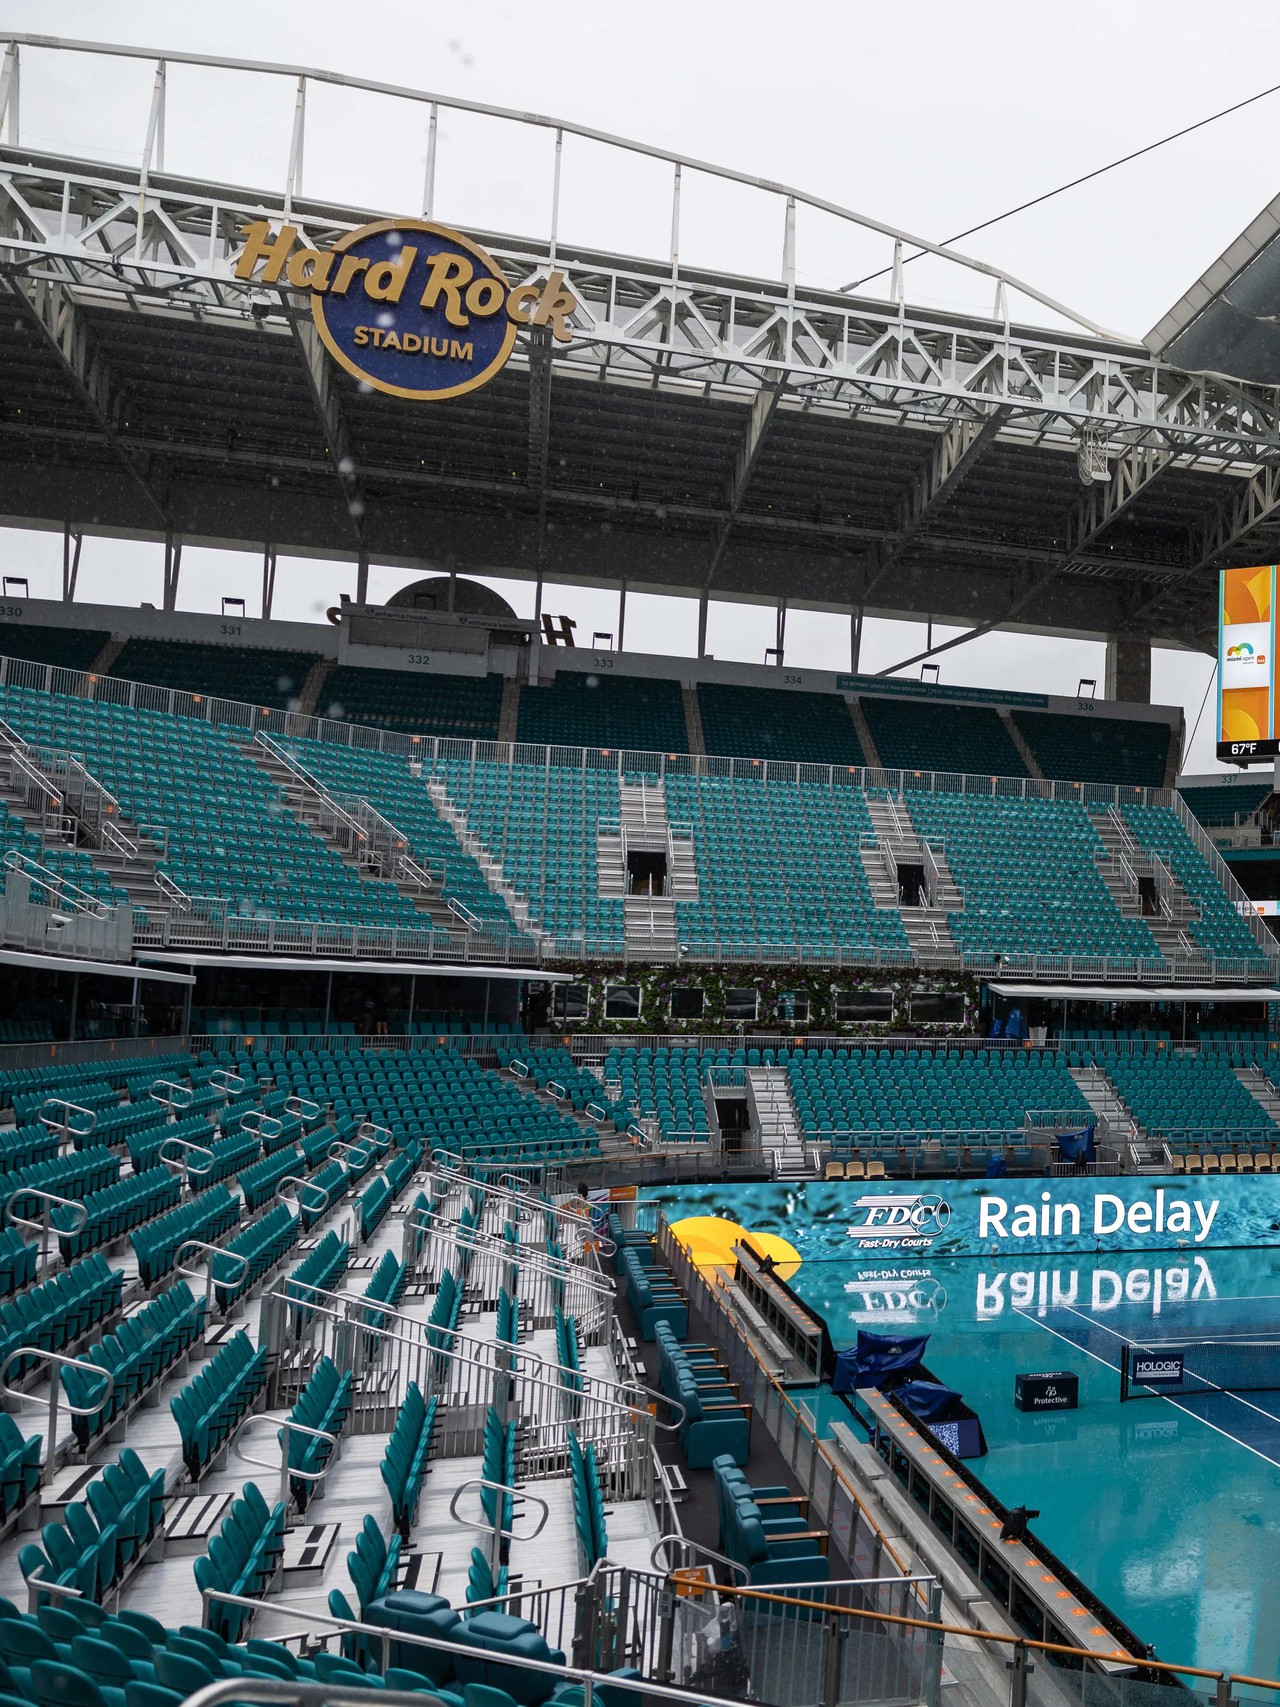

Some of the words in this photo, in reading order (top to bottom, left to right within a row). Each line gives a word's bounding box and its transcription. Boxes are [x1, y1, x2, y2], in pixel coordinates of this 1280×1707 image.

[234, 221, 418, 304] Hard
[420, 251, 577, 343] Rock
[353, 325, 474, 361] STADIUM
[220, 625, 241, 636] 331
[408, 654, 430, 665] 332
[593, 658, 614, 669] 333
[784, 675, 802, 685] 334
[1078, 702, 1094, 711] 336
[1231, 743, 1257, 754] 67°F
[1221, 774, 1238, 783] 337
[861, 1204, 937, 1227] FDC
[978, 1191, 1081, 1238] Rain
[1093, 1188, 1221, 1243] Delay
[858, 1238, 900, 1249] Fast-Dry
[901, 1237, 933, 1248] Courts
[1136, 1361, 1181, 1371] HOLOGIC
[1034, 1397, 1068, 1405] Protective
